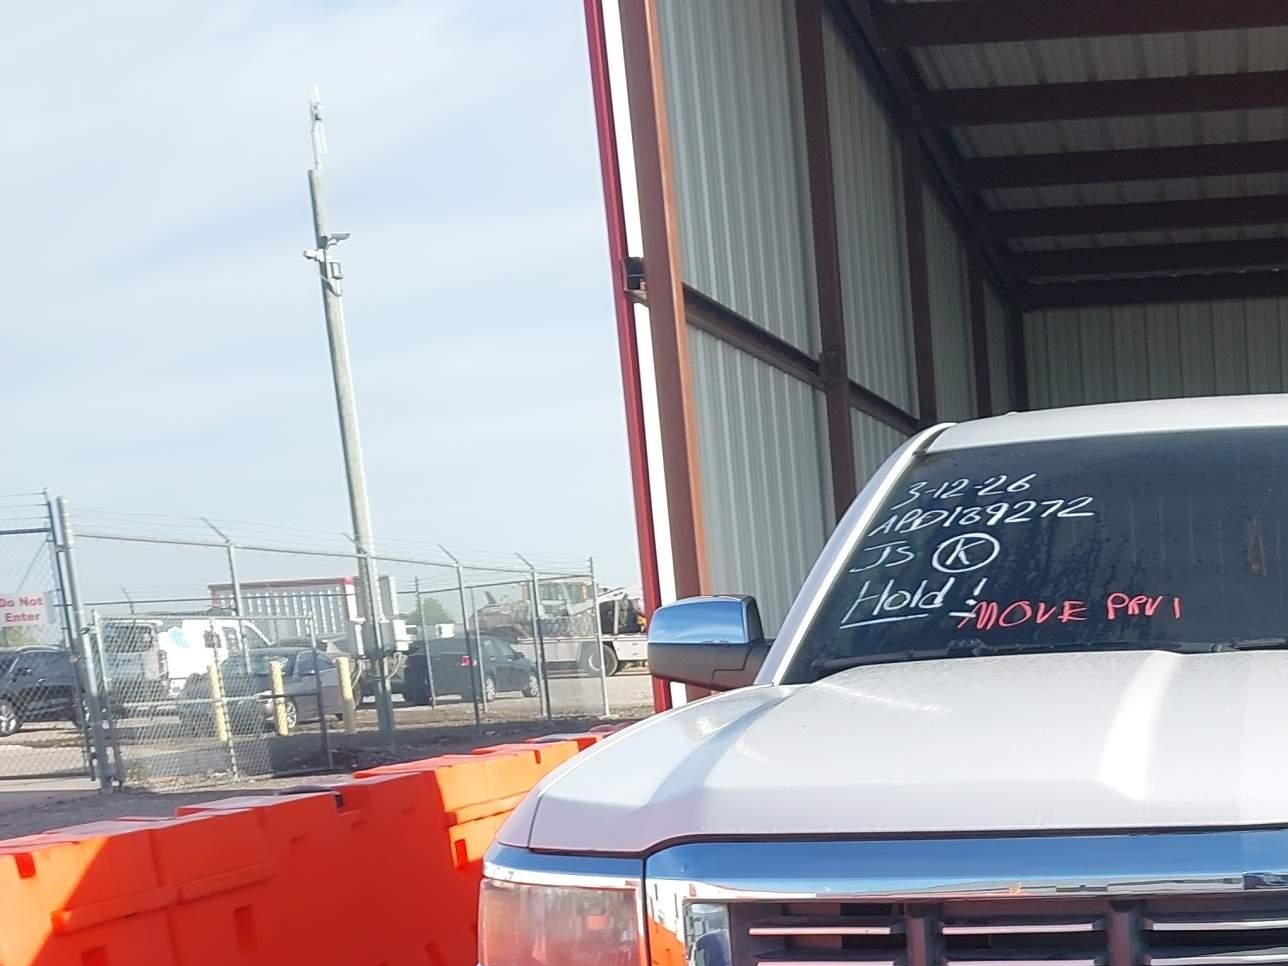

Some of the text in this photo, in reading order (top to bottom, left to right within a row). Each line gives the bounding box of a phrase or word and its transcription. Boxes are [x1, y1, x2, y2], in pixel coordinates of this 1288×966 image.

[892, 473, 1037, 510] 3-12-26
[19, 596, 43, 607] Not
[841, 576, 956, 625] Hold
[957, 600, 1088, 630] MOVE
[4, 612, 40, 622] Enter
